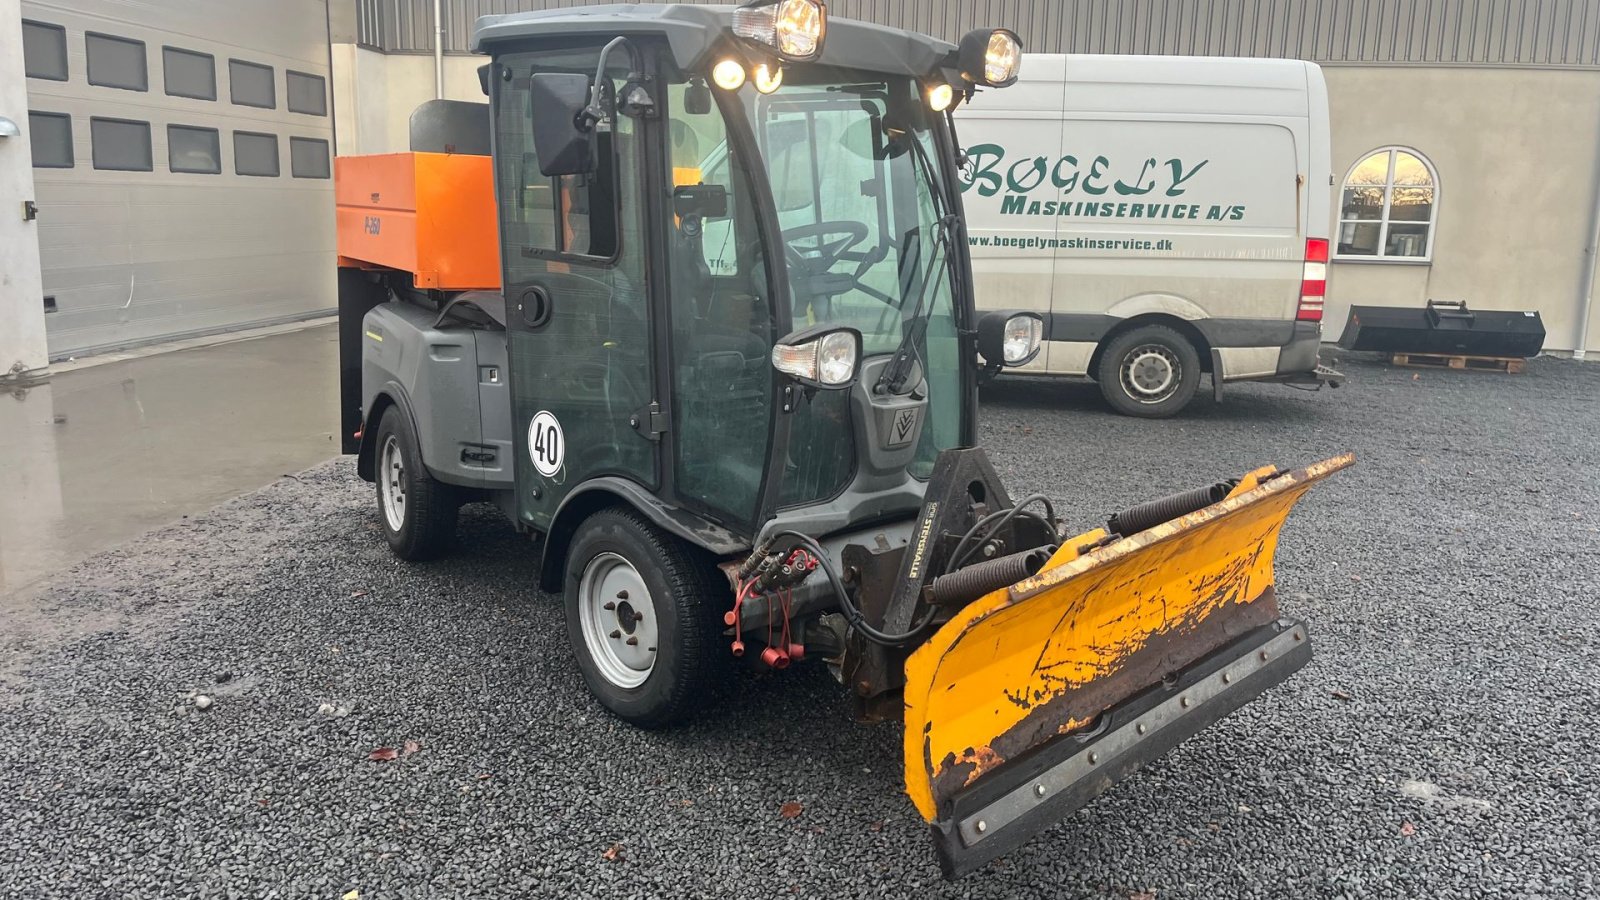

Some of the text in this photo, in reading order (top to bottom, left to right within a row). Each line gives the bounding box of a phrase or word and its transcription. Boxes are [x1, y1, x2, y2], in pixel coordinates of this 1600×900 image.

[1206, 205, 1245, 221] A/S
[365, 216, 381, 235] P-260
[535, 422, 558, 465] 40
